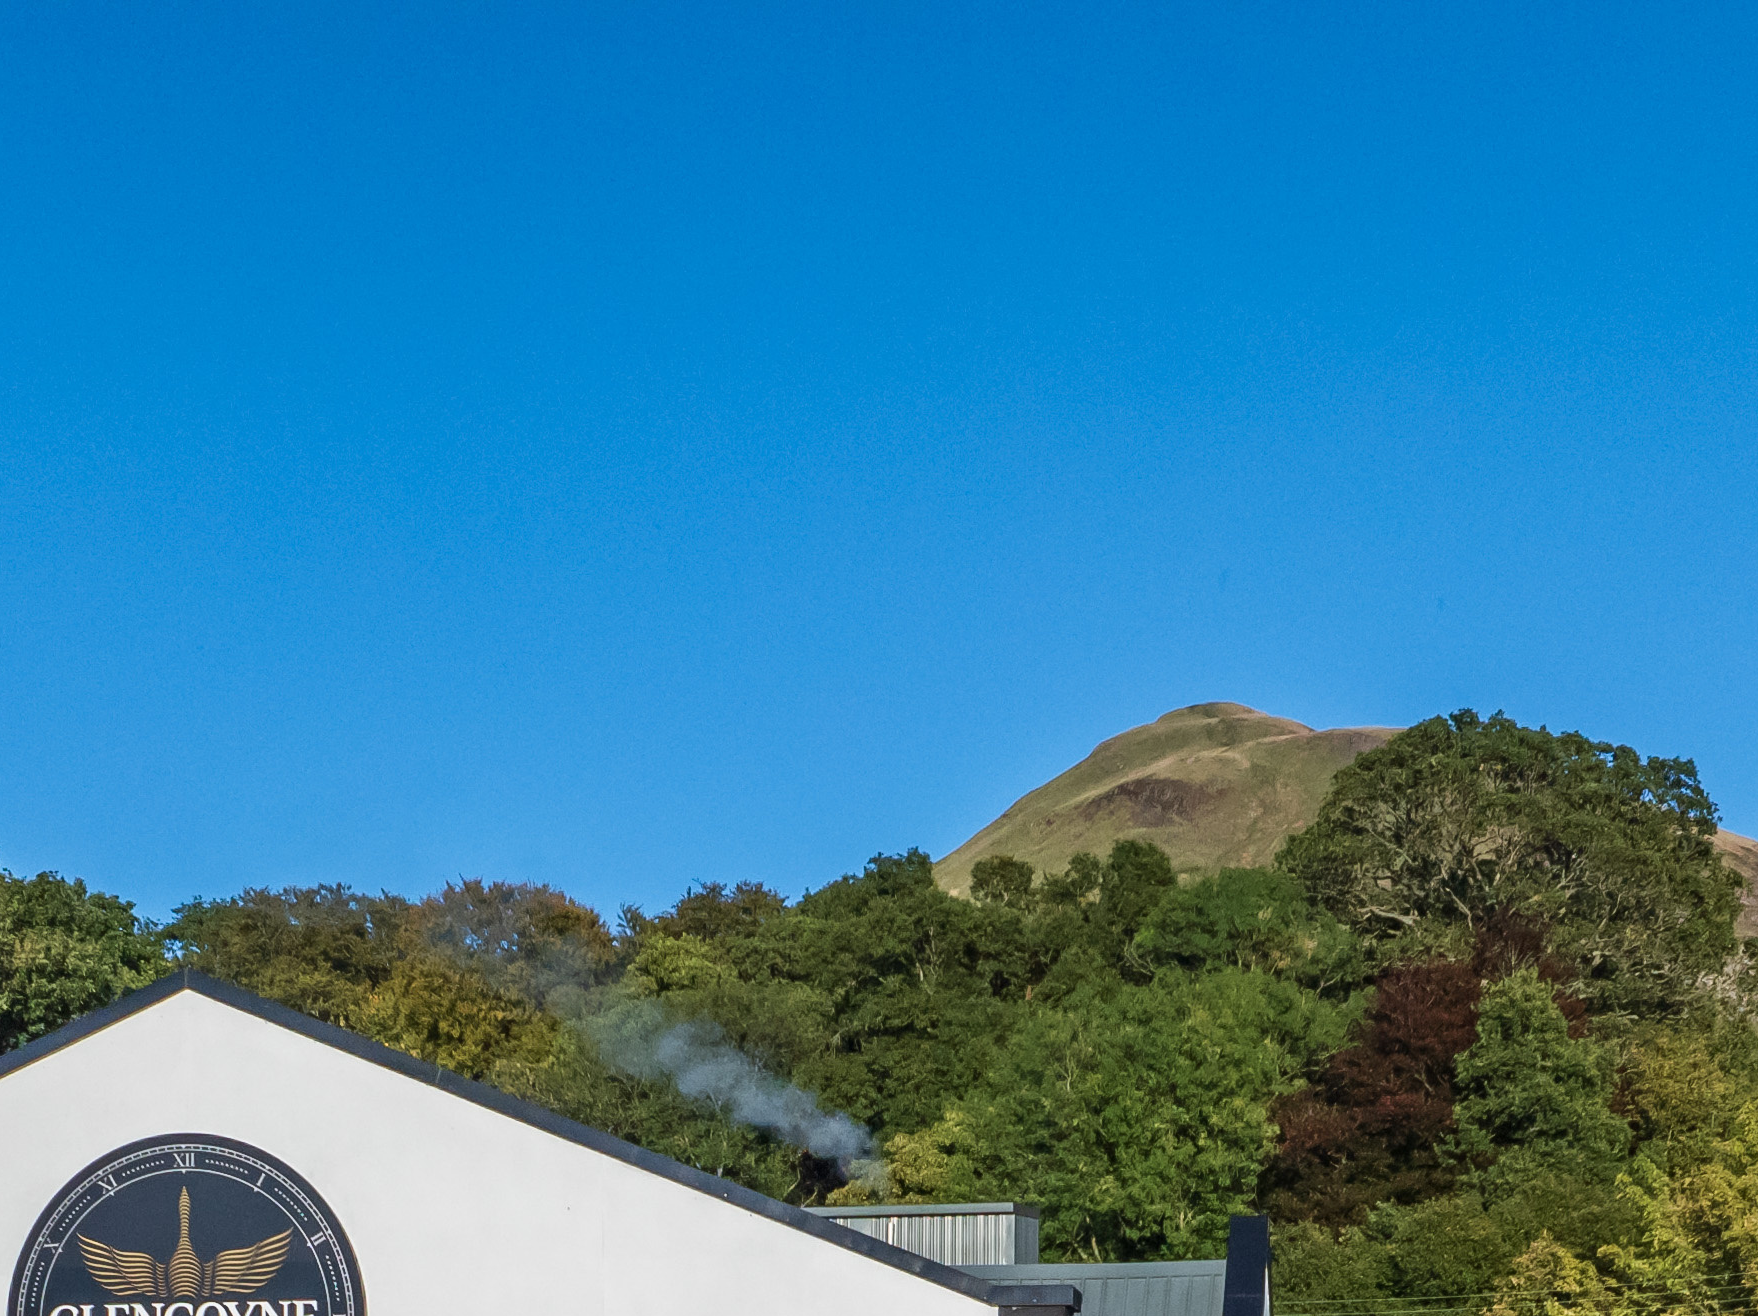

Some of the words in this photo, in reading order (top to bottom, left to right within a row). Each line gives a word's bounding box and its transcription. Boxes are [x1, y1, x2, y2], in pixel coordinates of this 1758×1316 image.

[173, 1153, 195, 1168] XII
[96, 1174, 118, 1195] XI
[256, 1173, 266, 1187] I
[43, 1237, 60, 1254] X
[310, 1231, 327, 1247] II
